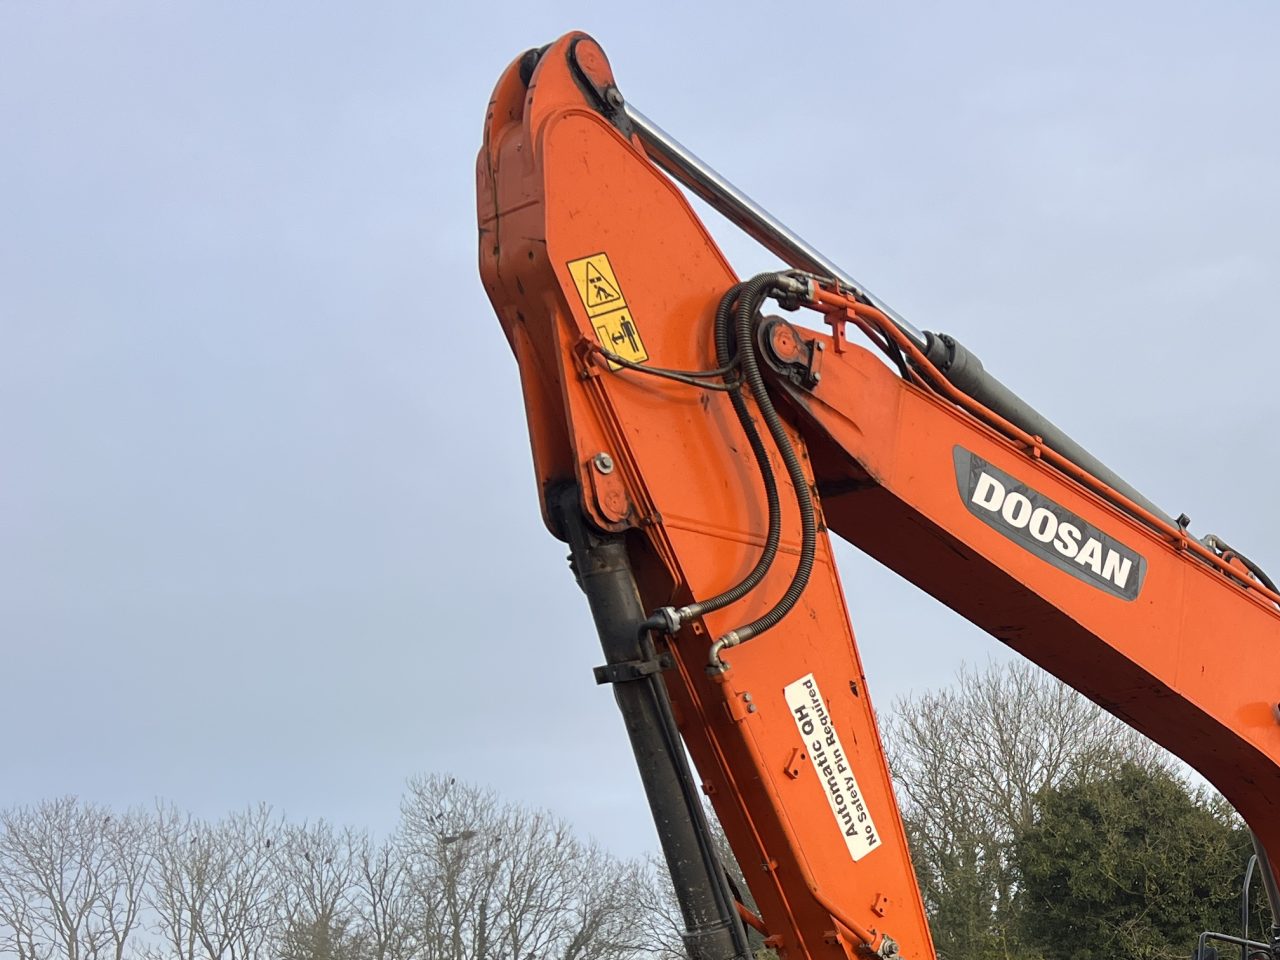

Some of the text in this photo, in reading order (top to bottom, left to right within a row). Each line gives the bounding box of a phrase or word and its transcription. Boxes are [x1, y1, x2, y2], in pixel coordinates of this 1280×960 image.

[971, 471, 1133, 589] DOOSAN
[794, 704, 859, 838] Automatic QH
[802, 679, 878, 847] No Safety Pin Required
